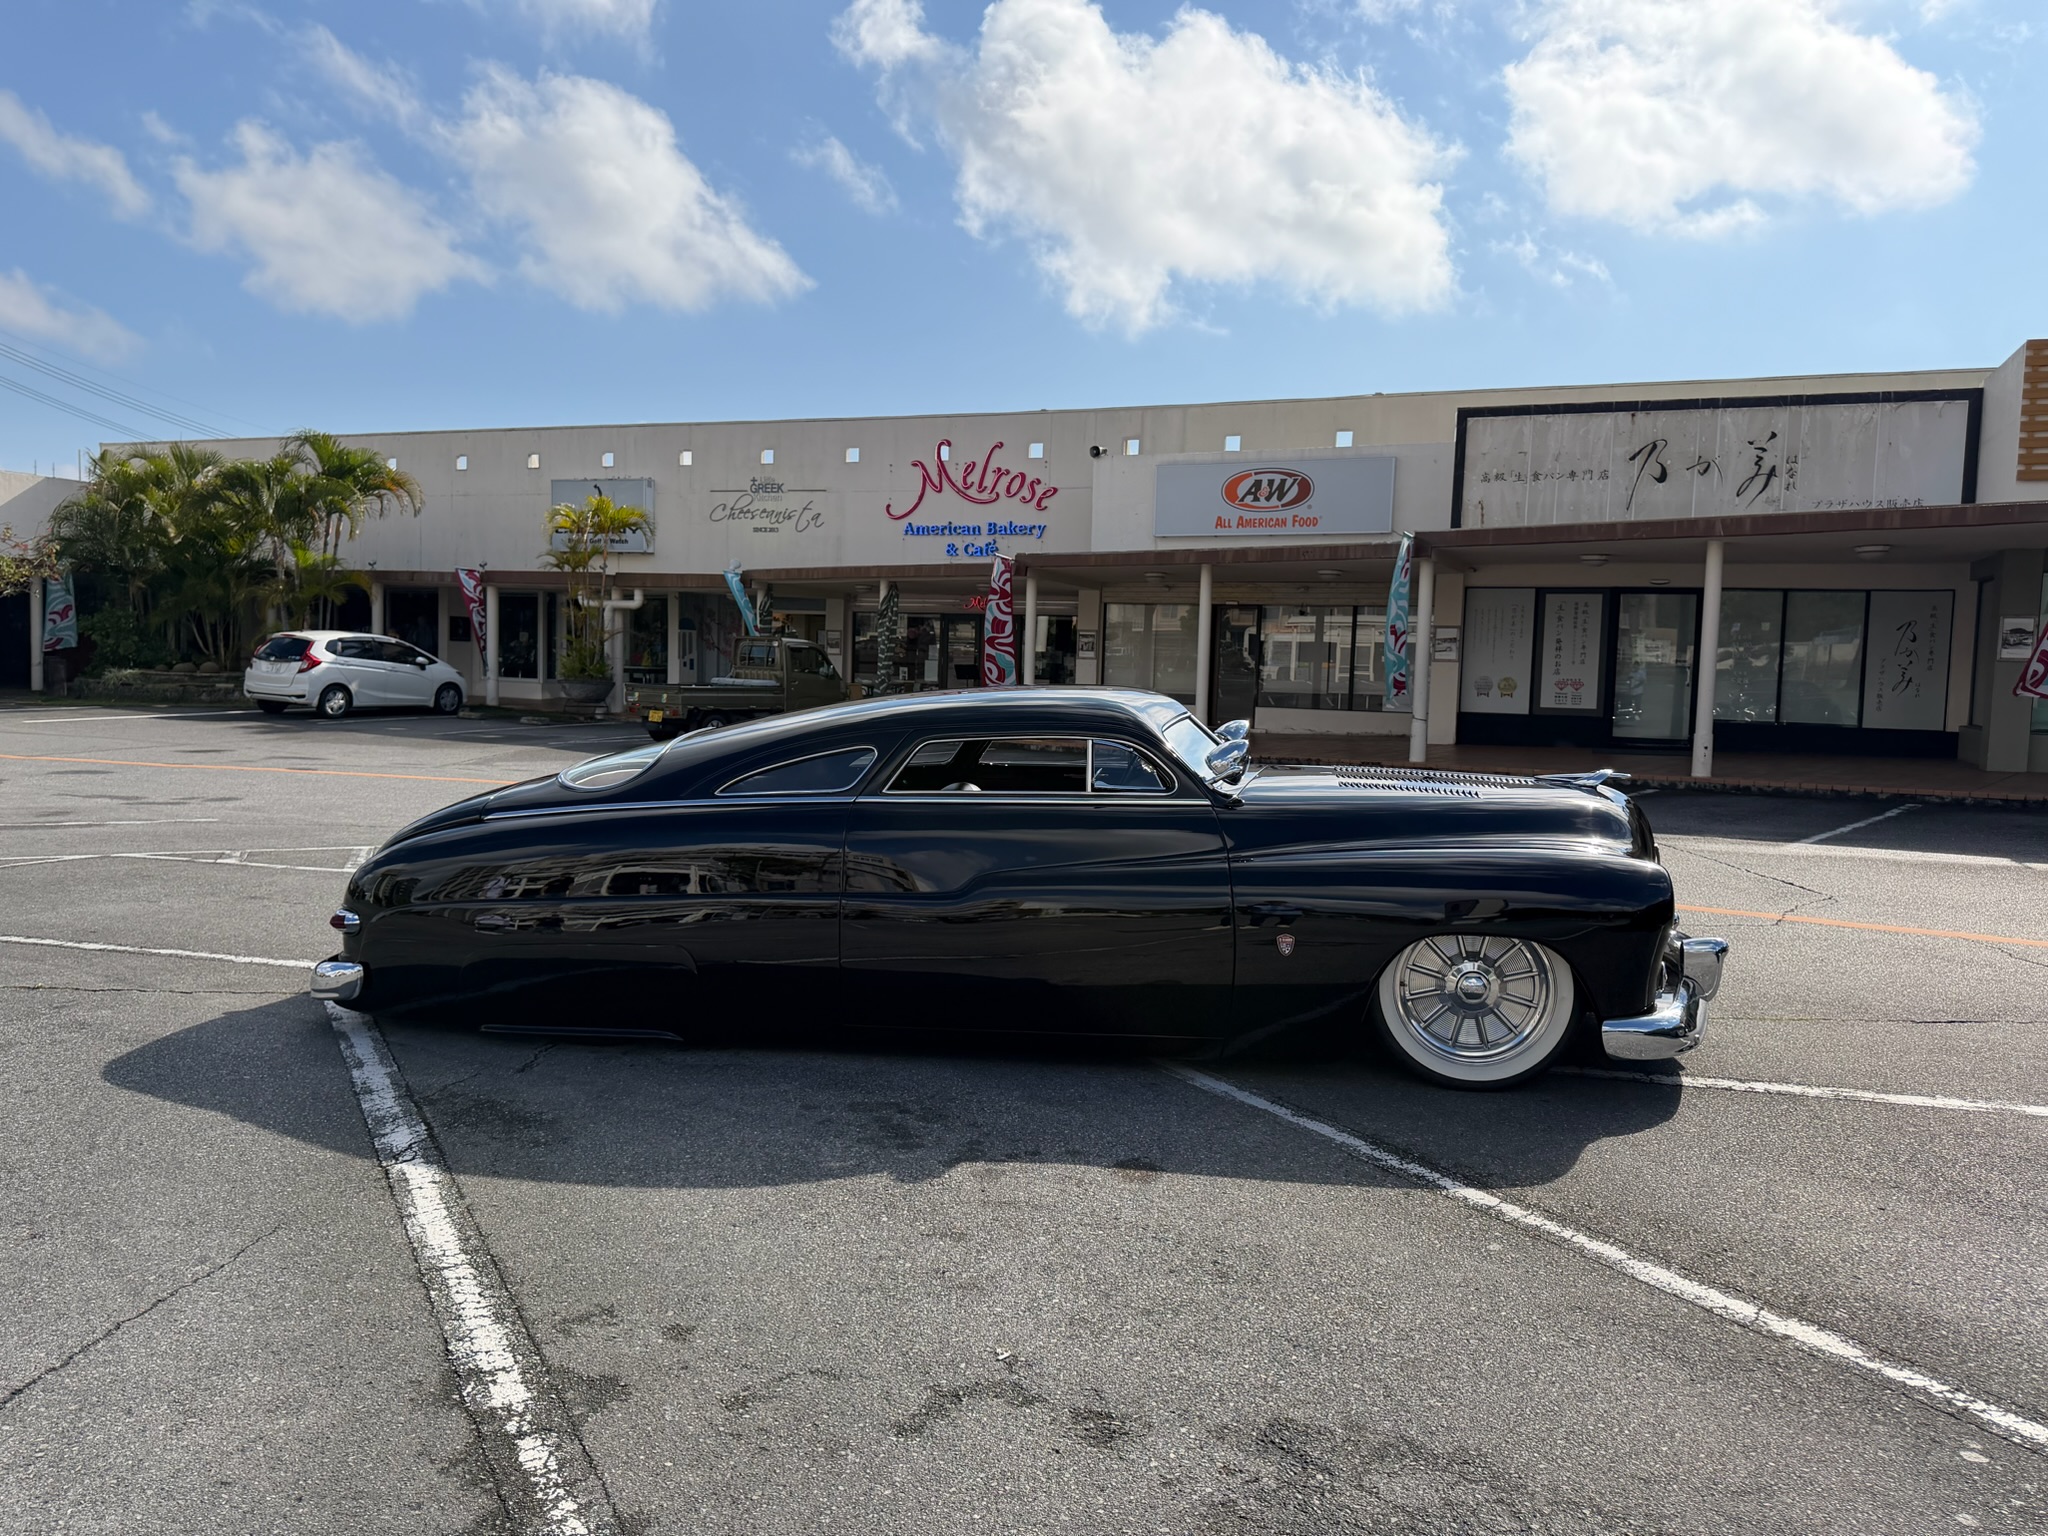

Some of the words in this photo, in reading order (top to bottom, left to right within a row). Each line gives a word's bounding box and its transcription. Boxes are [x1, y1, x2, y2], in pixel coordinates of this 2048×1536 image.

[886, 439, 1058, 520] Melrose
[1785, 455, 1798, 491] はなれ
[750, 483, 784, 494] GREEK
[1237, 478, 1301, 502] A&W
[903, 522, 982, 537] American
[986, 521, 1047, 539] Bakery
[945, 543, 959, 557] &
[963, 539, 1000, 557] Café
